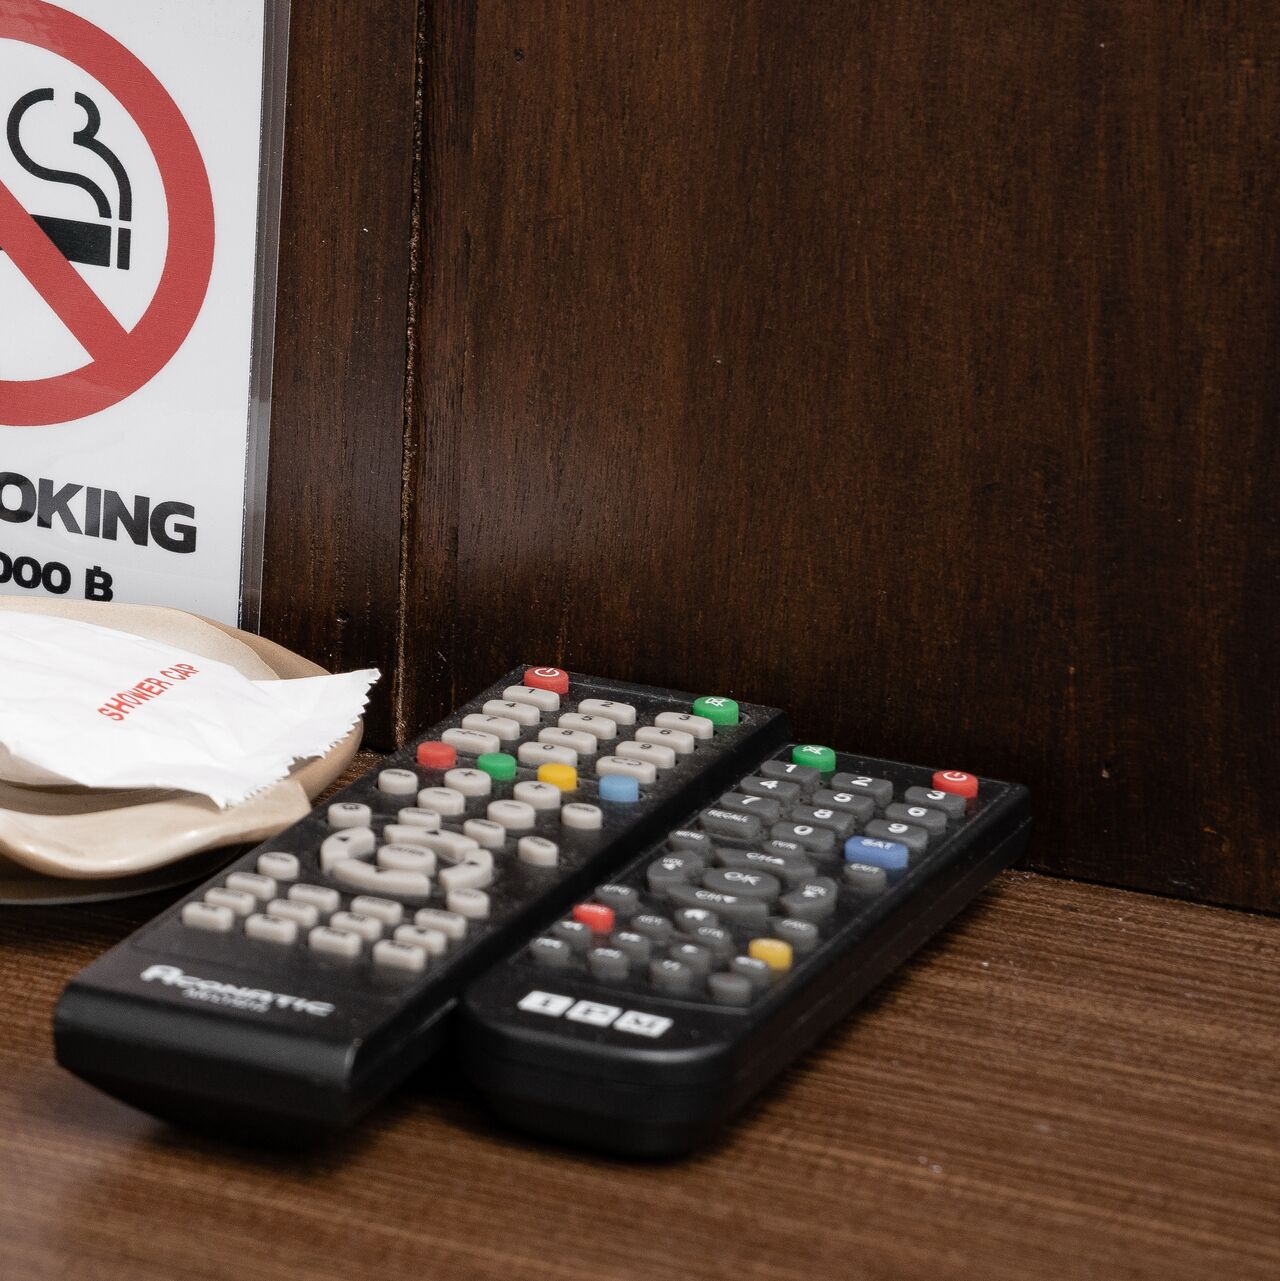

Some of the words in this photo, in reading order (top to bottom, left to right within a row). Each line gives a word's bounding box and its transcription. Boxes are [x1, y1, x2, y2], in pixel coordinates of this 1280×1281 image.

[97, 677, 174, 721] SHOWER
[160, 663, 200, 681] CAP
[785, 764, 797, 773] 1
[759, 780, 779, 790] 4
[851, 776, 873, 787] 2
[741, 795, 761, 805] 7
[833, 792, 852, 803] 5
[926, 790, 946, 801] 3
[707, 809, 749, 823] RECALL
[813, 809, 833, 819] 8
[908, 807, 927, 817] 6
[793, 825, 814, 836] 0
[887, 823, 908, 834] 9
[861, 838, 893, 850] SAT
[724, 871, 761, 886] OK
